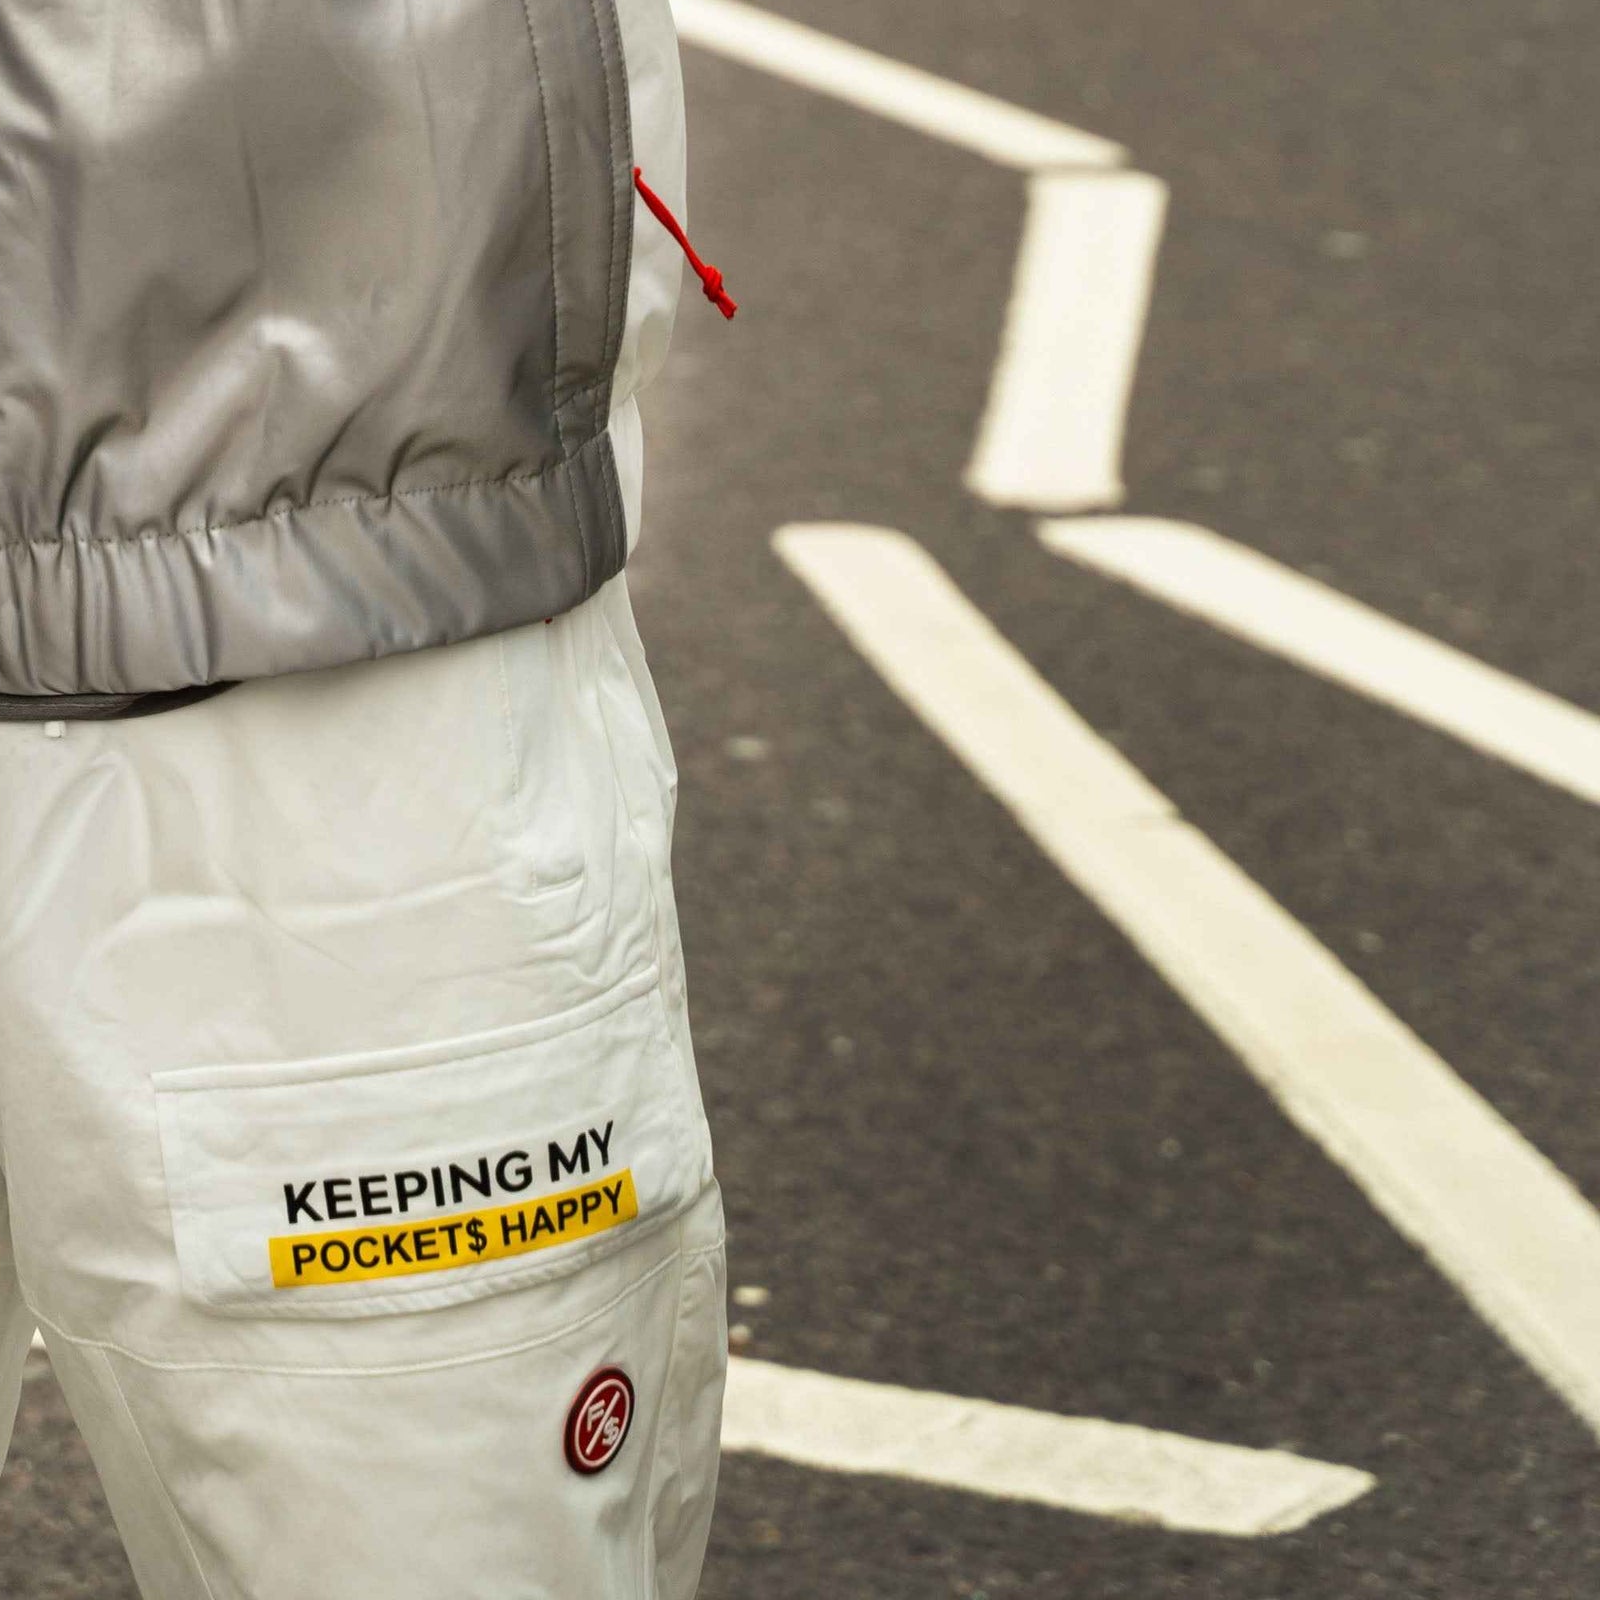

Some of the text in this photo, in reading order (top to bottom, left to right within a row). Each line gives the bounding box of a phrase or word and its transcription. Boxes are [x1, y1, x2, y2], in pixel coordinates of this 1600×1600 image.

[282, 1119, 615, 1224] KEEPING MY
[291, 1179, 624, 1277] POCKET$ HAPPY
